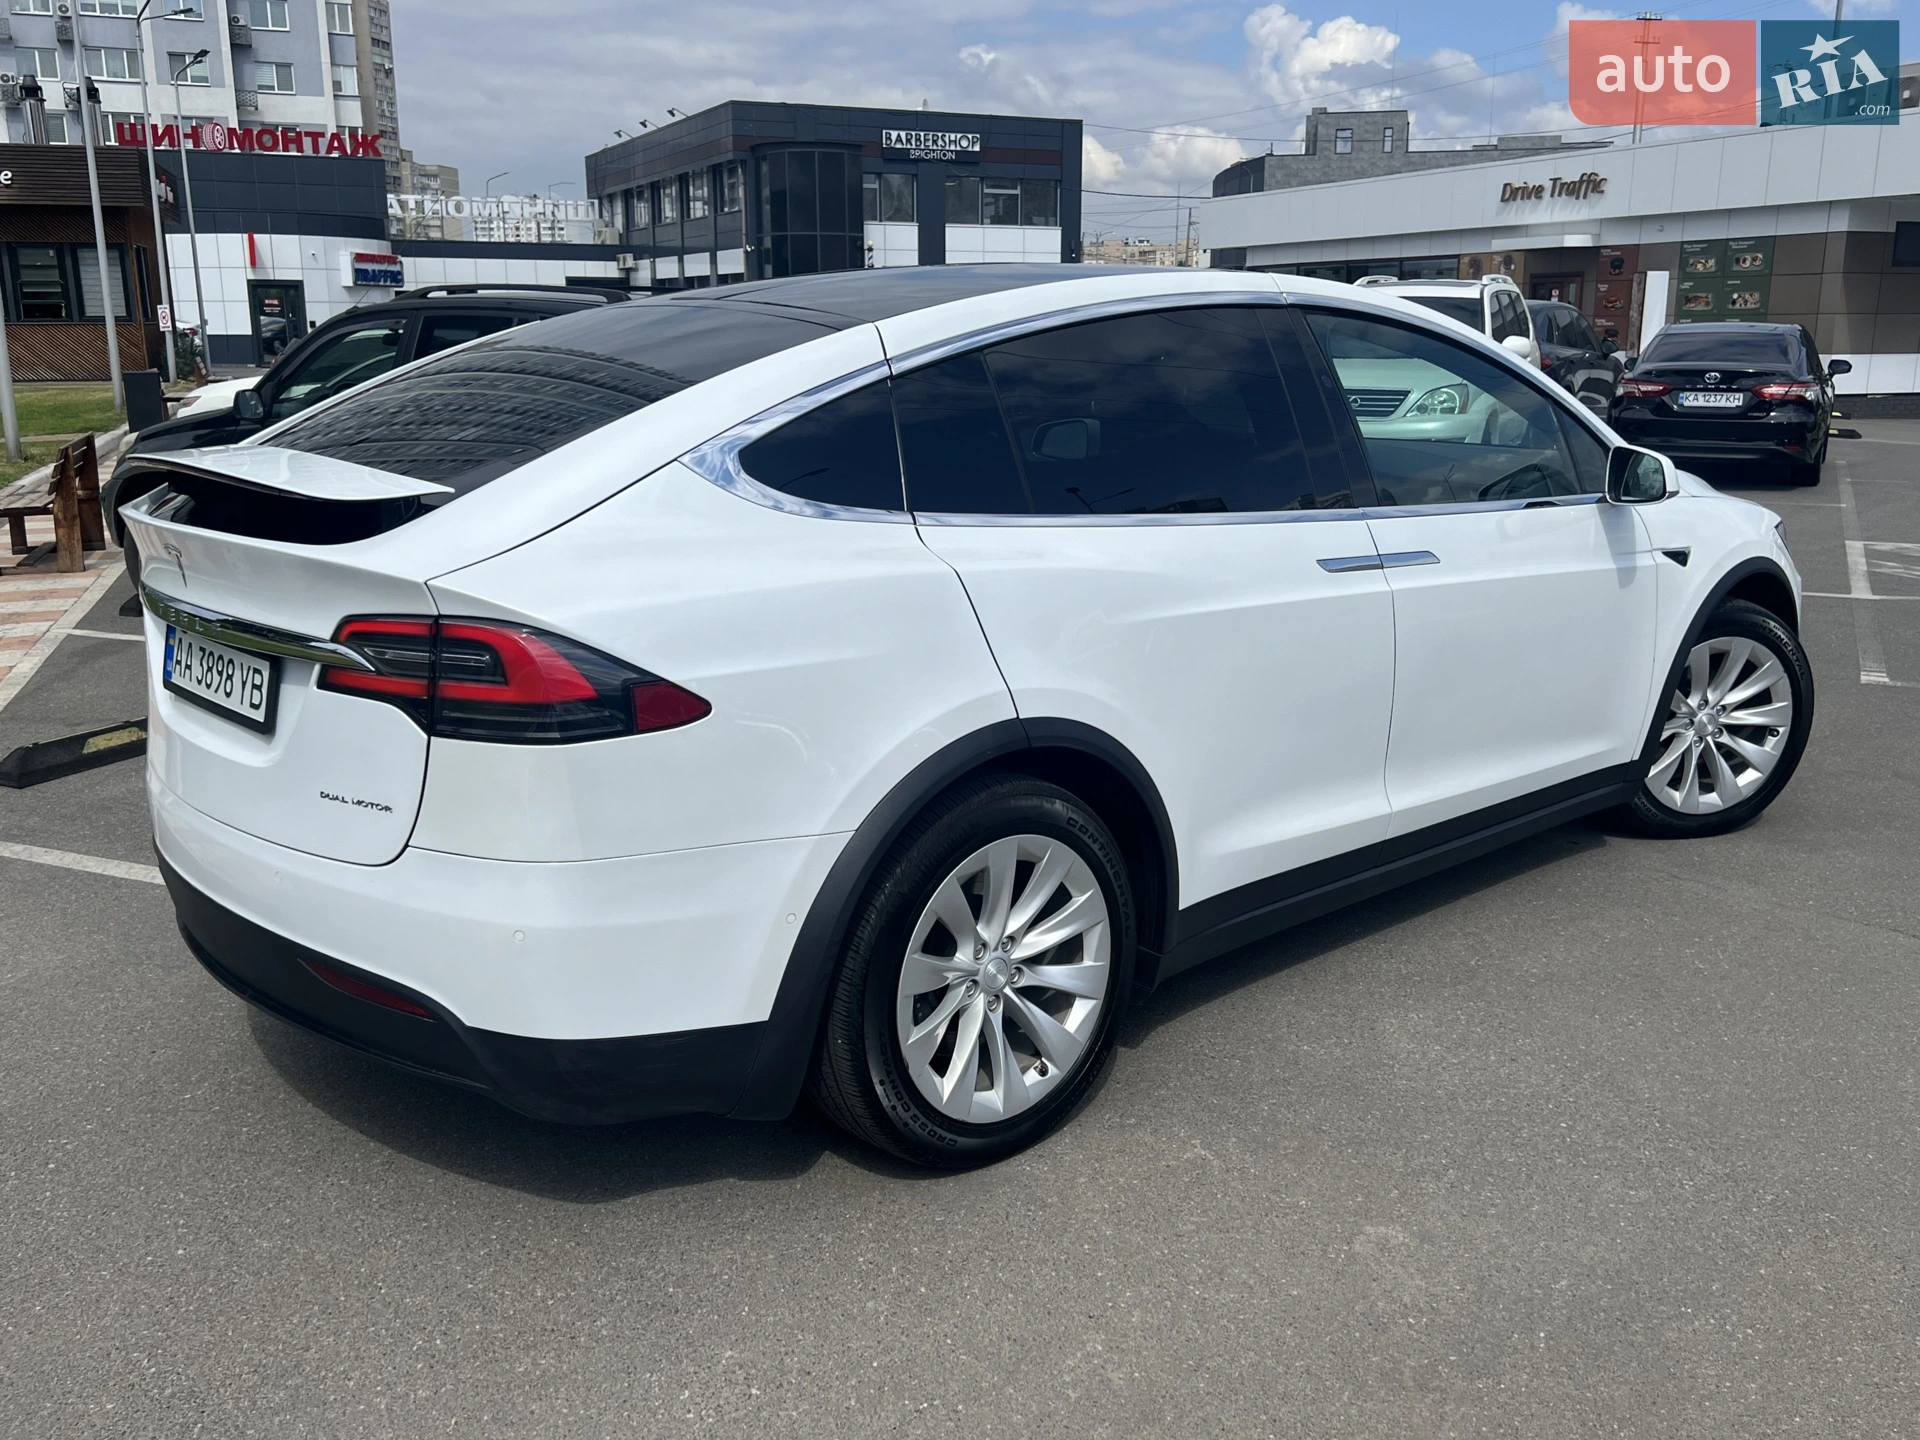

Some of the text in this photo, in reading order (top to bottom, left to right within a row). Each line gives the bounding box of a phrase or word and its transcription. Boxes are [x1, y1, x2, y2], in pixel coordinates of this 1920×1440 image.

[884, 131, 980, 149] BARBERSHOP
[909, 149, 956, 160] BRIGHTON
[1500, 171, 1608, 203] Drive Traffic
[354, 267, 403, 285] TRAFFIC
[1684, 393, 1741, 405] KA 1237 KH
[173, 636, 265, 711] AA 3898 YB
[320, 791, 393, 814] DUAL MOTOR
[1065, 816, 1132, 940] CONTINENTAL
